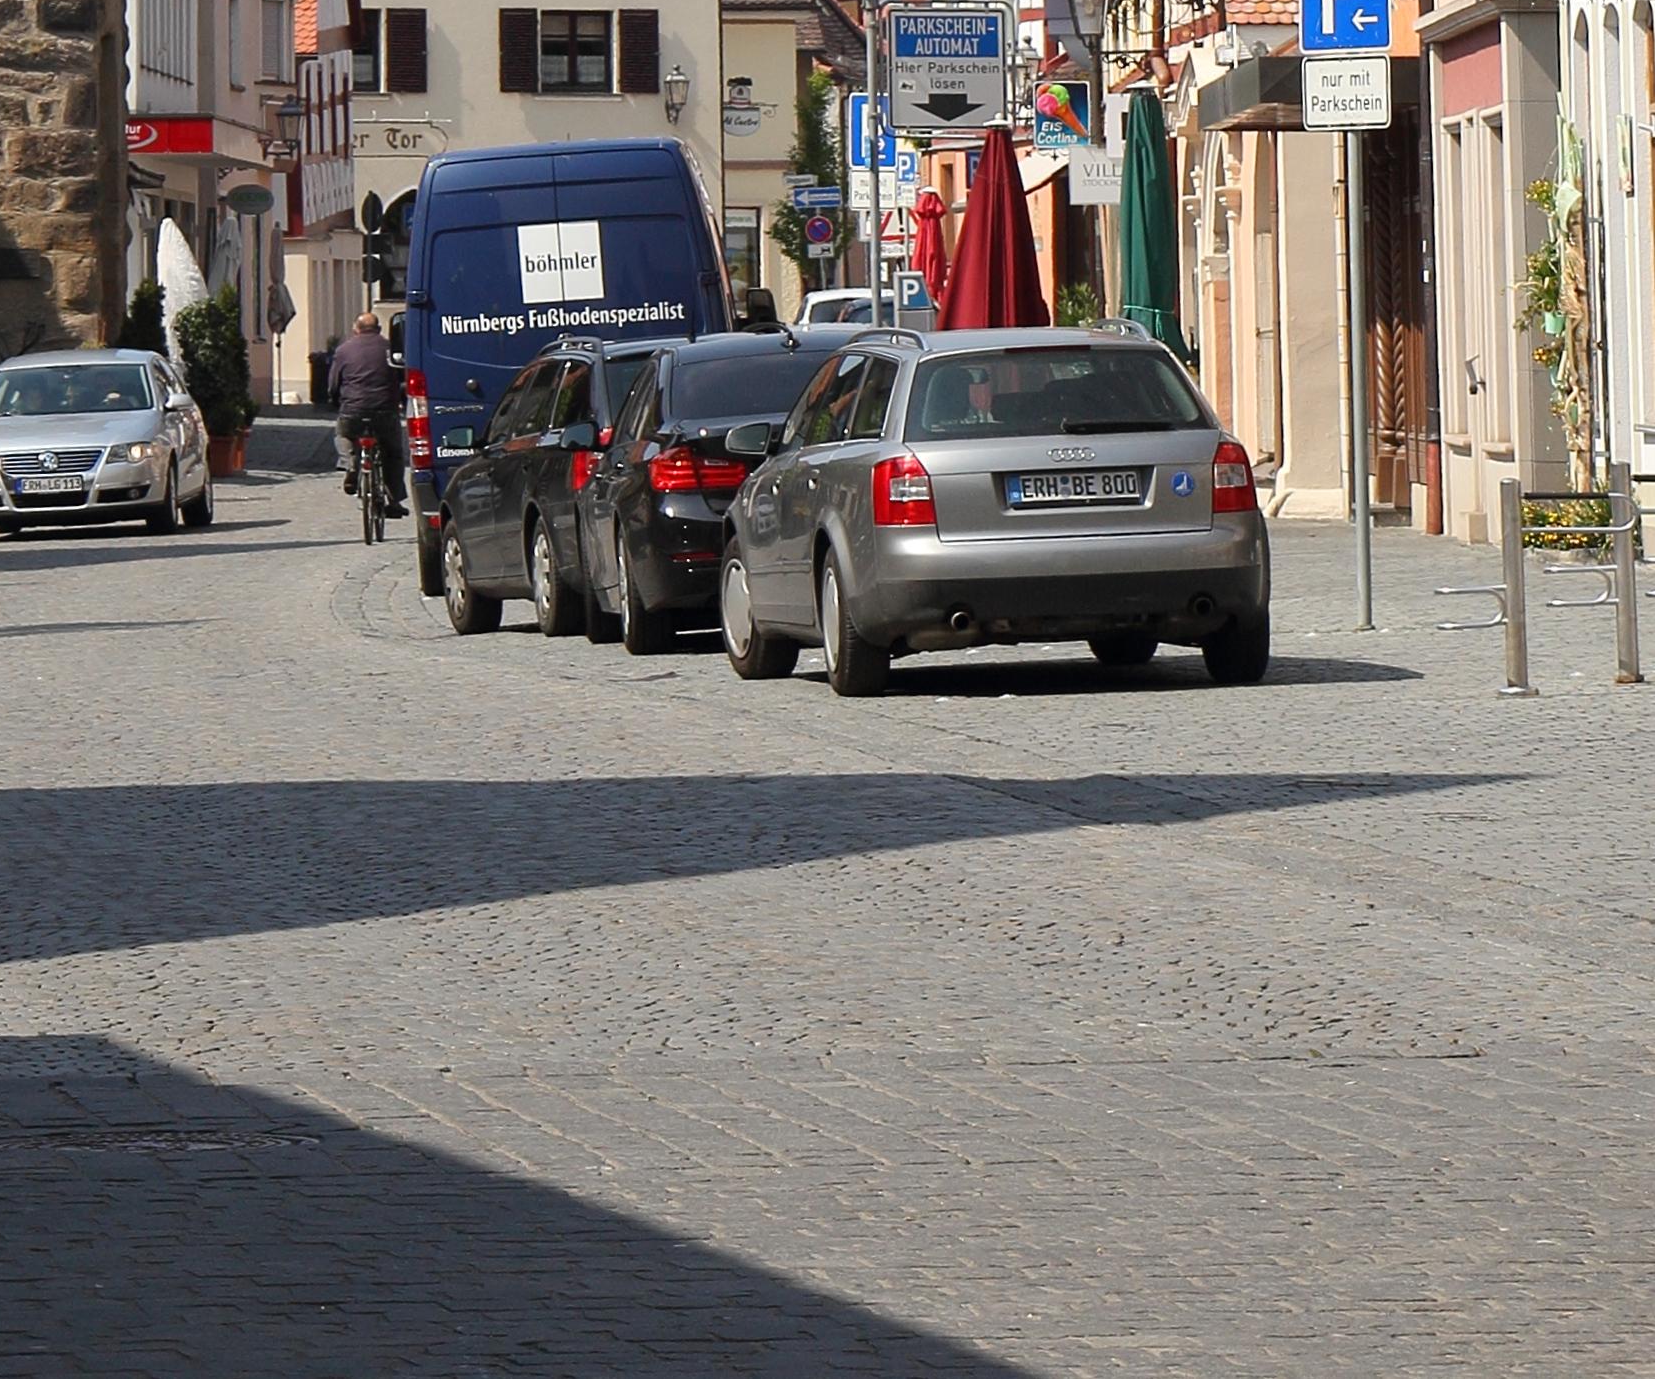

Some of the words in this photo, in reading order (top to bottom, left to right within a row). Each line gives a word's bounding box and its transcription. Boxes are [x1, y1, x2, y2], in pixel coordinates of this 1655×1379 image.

[899, 17, 995, 35] PARKSCHEIN-
[914, 37, 980, 55] AUTOMAT
[895, 61, 923, 74] Hier
[927, 61, 1000, 74] Parkschein
[929, 77, 966, 89] lösen
[1321, 72, 1343, 88] nur
[1349, 69, 1371, 87] mit
[1311, 94, 1383, 113] Parkschein
[125, 124, 142, 134] tur
[384, 127, 423, 149] Tor
[1037, 132, 1078, 144] Cortina
[898, 155, 911, 180] P
[1083, 163, 1122, 178] VILL
[1082, 179, 1122, 187] STOCKHO
[524, 251, 598, 274] böhmler
[903, 278, 920, 306] P
[441, 312, 525, 336] Nürnbergs
[528, 301, 685, 328] Fußbodenspezialist
[63, 478, 81, 490] 113
[1021, 476, 1058, 499] ERH
[1072, 474, 1097, 496] BE
[1102, 473, 1138, 495] 800
